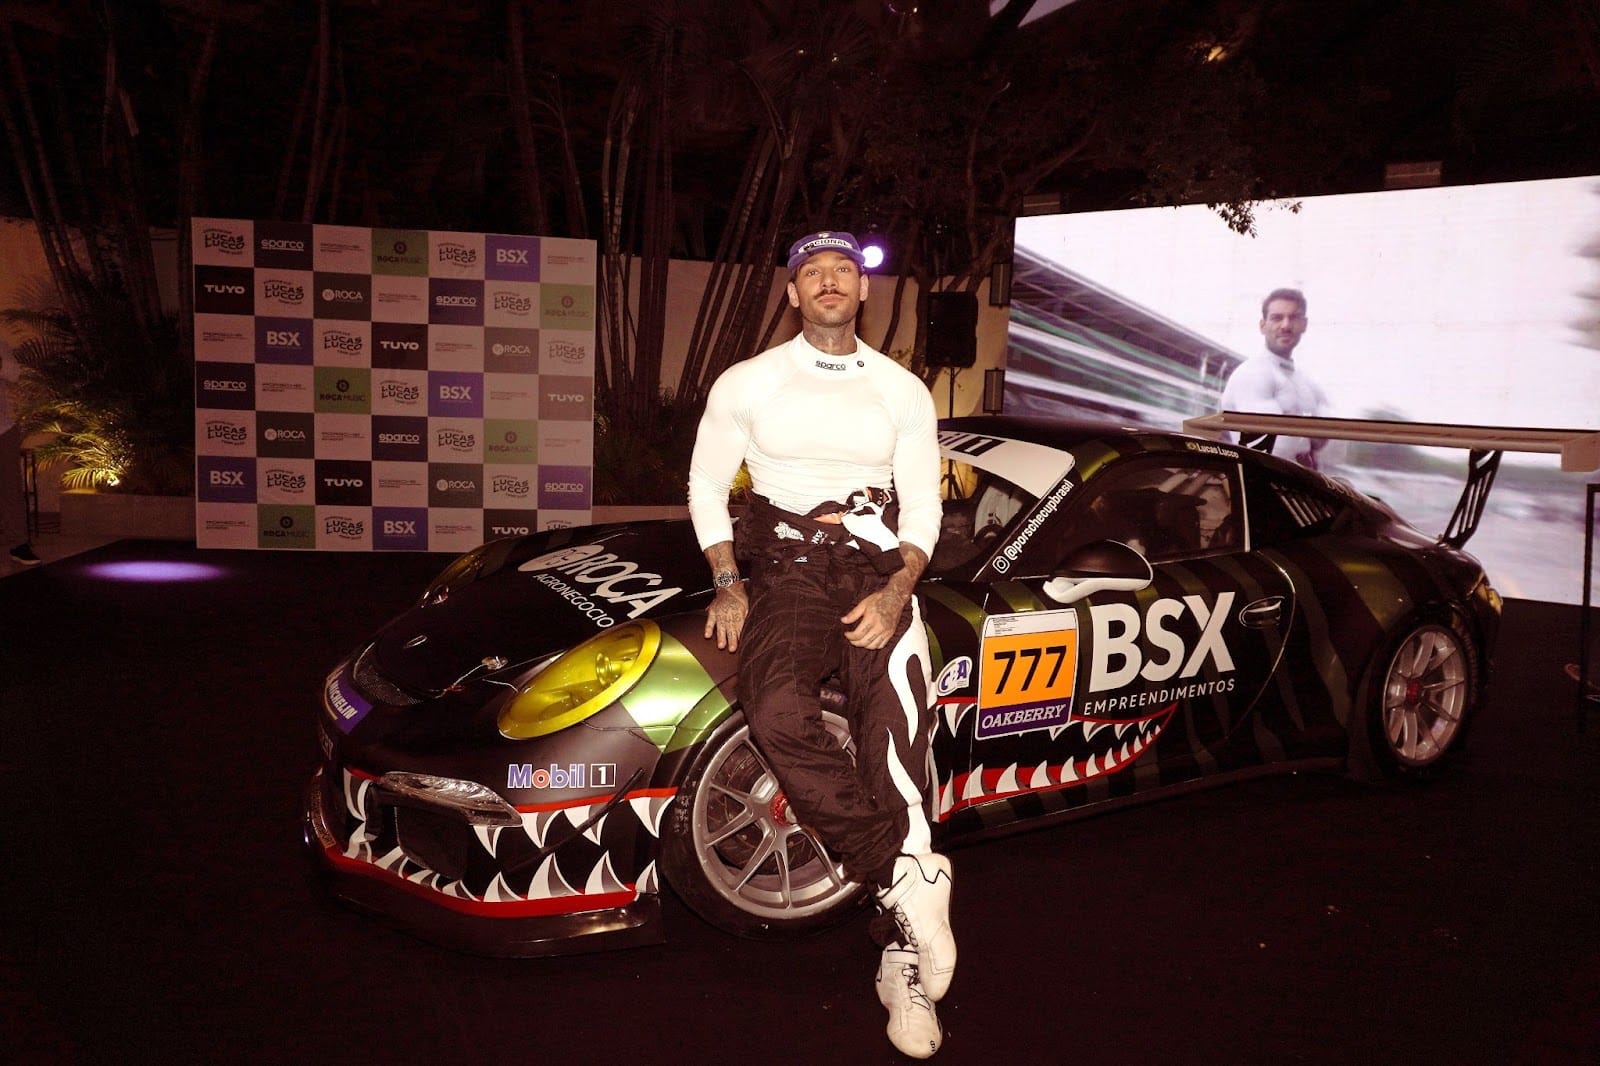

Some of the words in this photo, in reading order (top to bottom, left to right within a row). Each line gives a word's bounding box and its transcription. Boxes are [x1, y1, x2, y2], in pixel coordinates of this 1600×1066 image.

[204, 232, 244, 242] LUCAS
[204, 240, 245, 250] LUCCO
[261, 239, 304, 251] sparco
[440, 247, 476, 256] LUCAS
[496, 249, 528, 264] BSX
[440, 254, 476, 263] LUCCO
[204, 284, 245, 294] TUYO
[265, 284, 304, 294] LUCAS
[265, 291, 304, 300] LUCCO
[335, 290, 363, 300] ROCA
[494, 295, 530, 305] LUCAS
[436, 296, 476, 306] sparco
[494, 302, 531, 312] LUCCO
[267, 331, 300, 346] BSX
[324, 334, 362, 344] LUCAS
[324, 342, 362, 350] LUCCO
[380, 341, 419, 350] TUYO
[504, 345, 531, 354] ROCA
[815, 360, 846, 370] sparco
[204, 380, 246, 391] sparco
[382, 384, 419, 393] LUCAS
[382, 391, 419, 400] LUCCO
[440, 386, 472, 400] BSX
[548, 394, 584, 402] TUYO
[207, 424, 246, 433] LUCAS
[207, 431, 247, 440] LUCCO
[277, 429, 306, 439] ROCA
[378, 433, 420, 444] sparco
[438, 432, 475, 441] LUCAS
[438, 439, 476, 448] LUCCO
[1195, 442, 1218, 454] Lucas
[210, 470, 244, 485] BSX
[267, 473, 305, 482] LUCAS
[267, 480, 306, 488] LUCCO
[324, 478, 363, 488] TUYO
[448, 480, 475, 489] ROCA
[493, 479, 529, 488] LUCAS
[545, 482, 584, 492] sparco
[493, 486, 530, 494] LUCCO
[326, 518, 363, 528] LUCAS
[1004, 478, 1074, 561] @porschecupbrasil
[326, 526, 364, 535] LUCCO
[384, 520, 416, 534] BSX
[492, 526, 529, 534] TUYO
[556, 553, 682, 620] ROCA
[532, 573, 614, 628] AGRONEGOCIO
[1089, 592, 1236, 693] BSX
[994, 645, 1067, 694] 777
[329, 680, 358, 720] MICHELIN
[1084, 678, 1235, 716] EMPREENDIMENTOS
[981, 704, 1067, 729] OAKBERRY
[507, 764, 584, 789] Mobil
